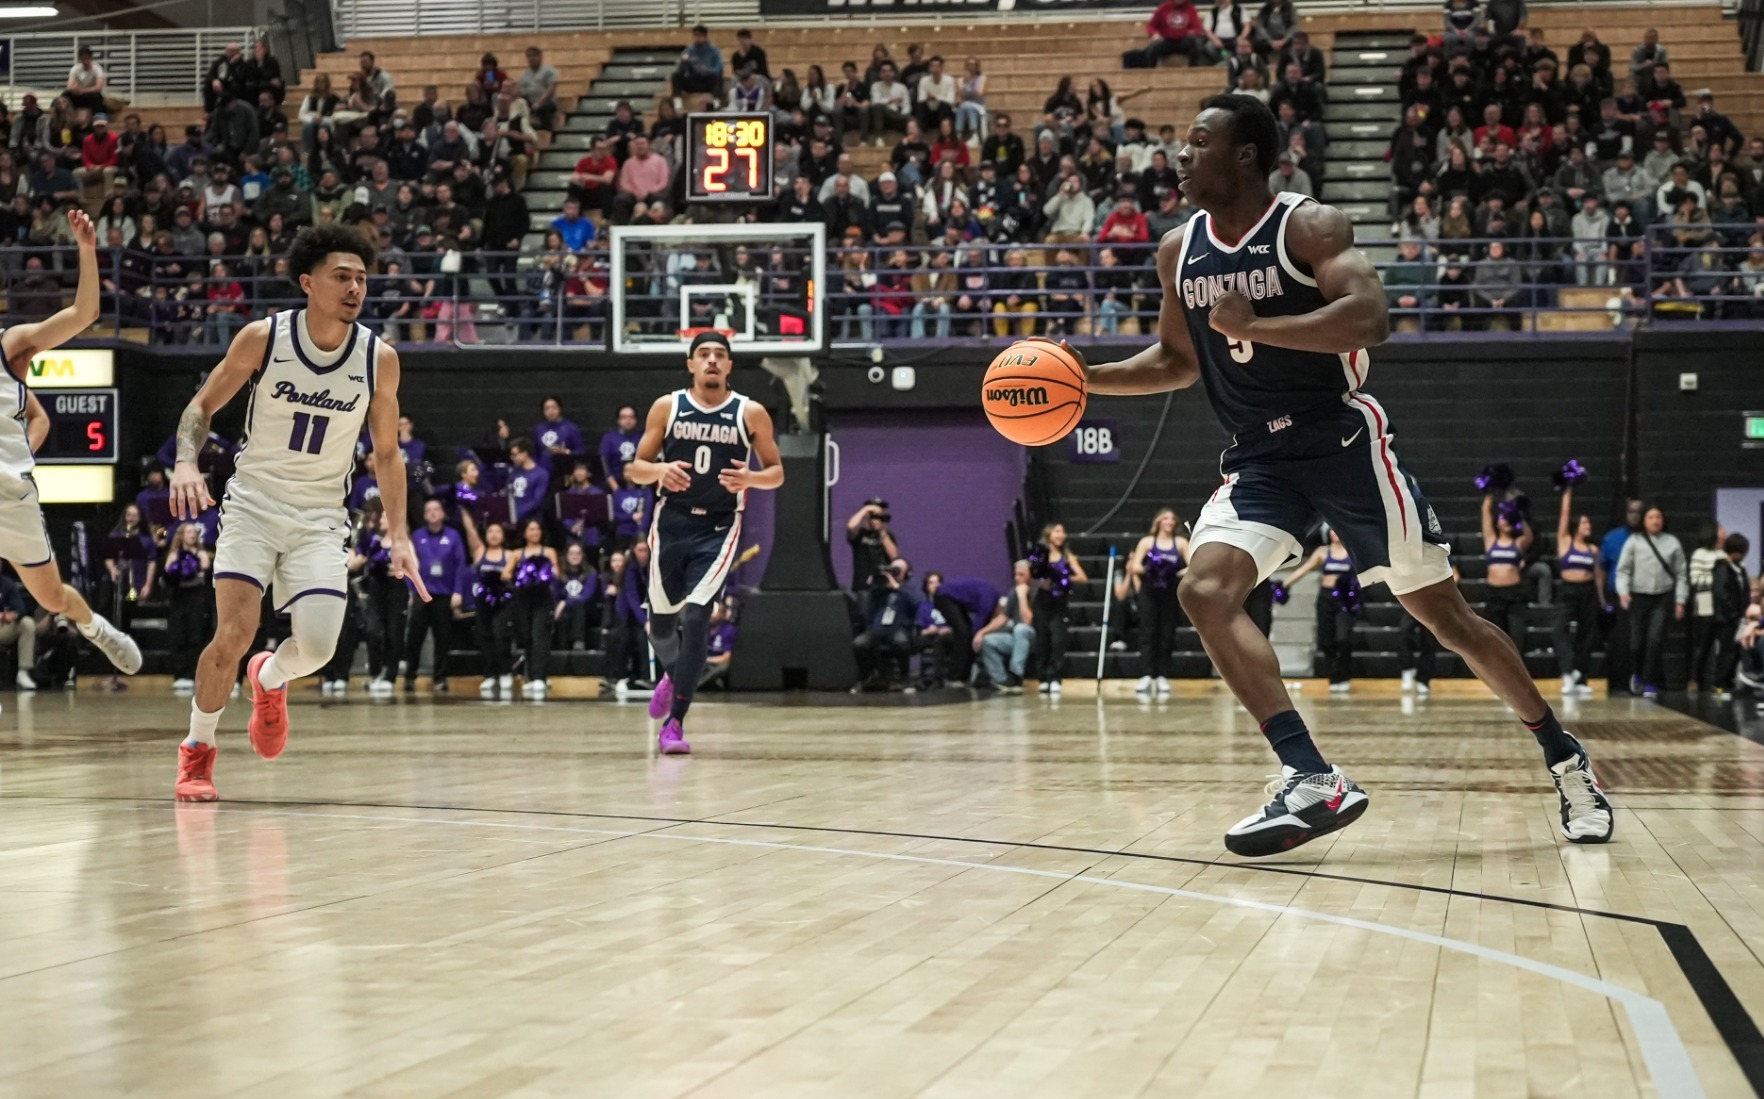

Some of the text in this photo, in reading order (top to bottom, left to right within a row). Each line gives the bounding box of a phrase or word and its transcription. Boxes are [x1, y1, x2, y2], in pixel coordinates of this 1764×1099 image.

[706, 121, 764, 147] 18:30
[704, 148, 757, 191] 27
[1248, 244, 1270, 254] WCC
[55, 395, 108, 414] GUEST
[271, 380, 361, 412] Portland
[986, 387, 1049, 406] Wilson
[87, 421, 105, 451] 5
[288, 411, 330, 455] 11
[673, 420, 738, 445] GONZAGA
[1266, 414, 1293, 433] ZAGS
[1075, 427, 1113, 455] 18B
[694, 445, 712, 475] 0
